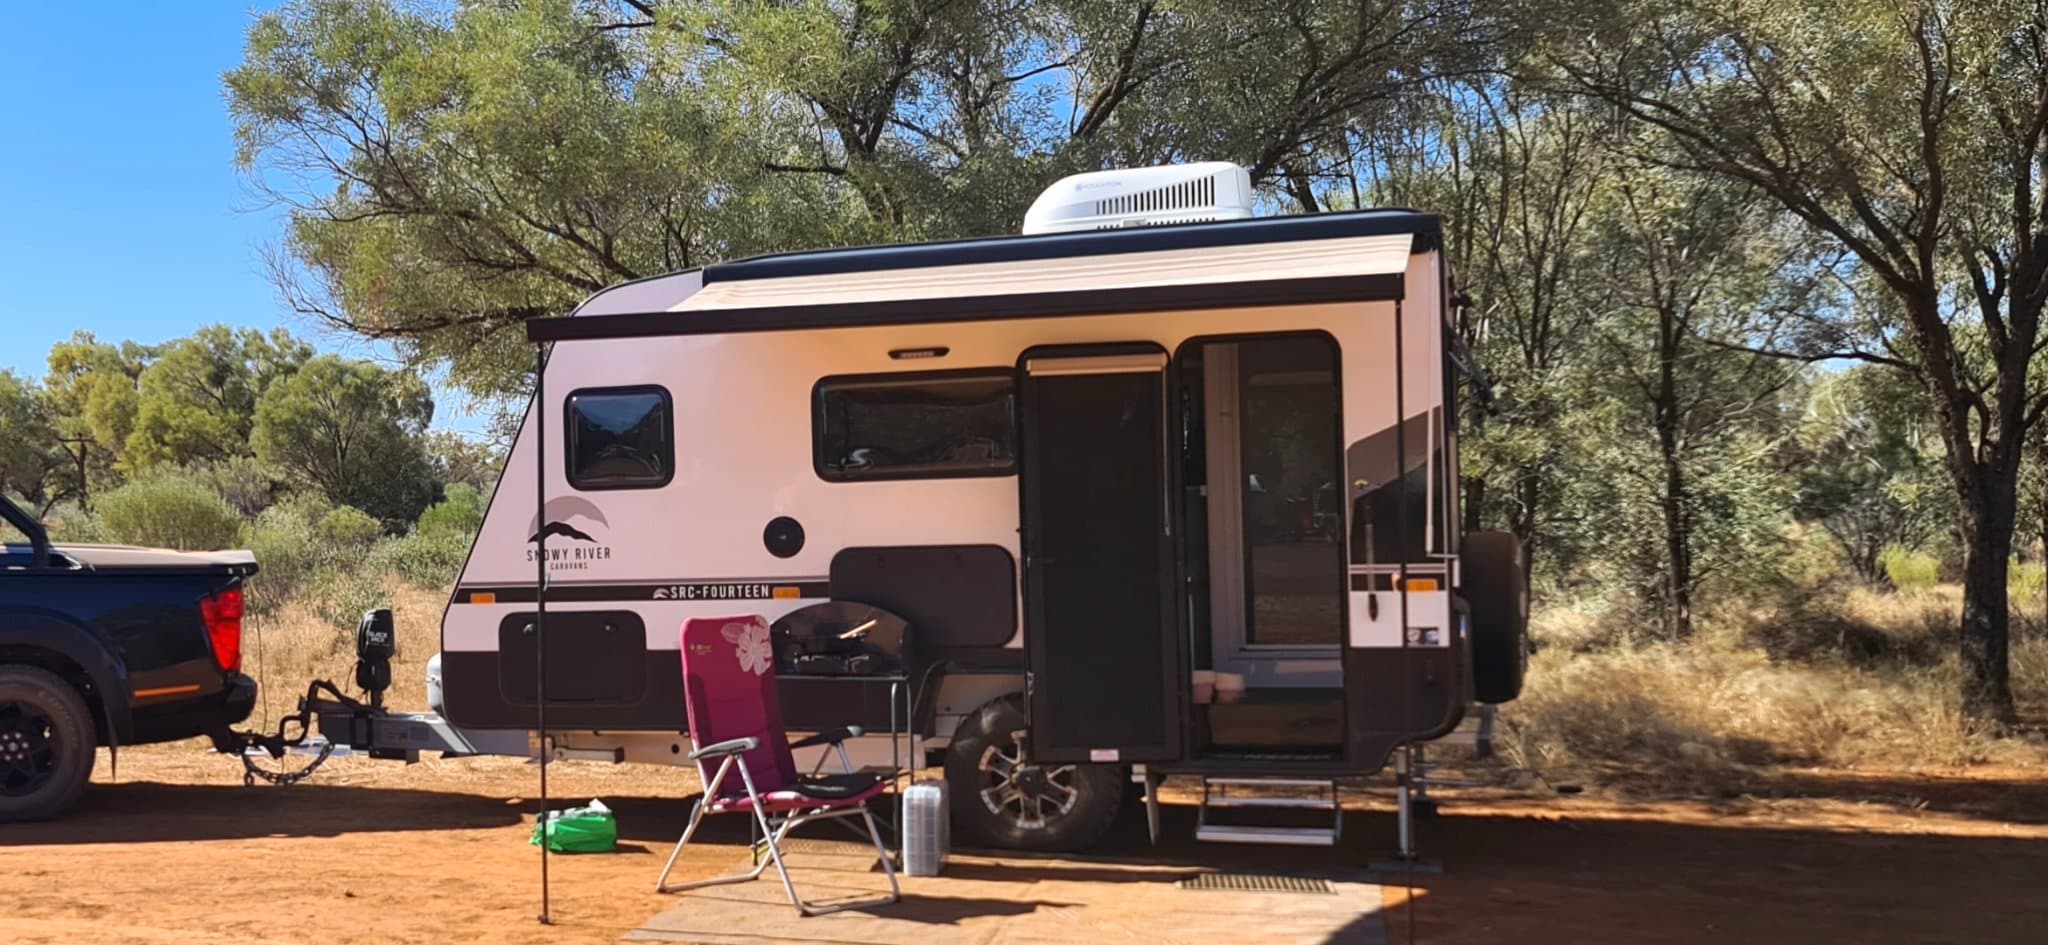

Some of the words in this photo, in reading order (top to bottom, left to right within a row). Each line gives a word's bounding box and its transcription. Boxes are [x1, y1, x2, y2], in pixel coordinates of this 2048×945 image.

[527, 548, 568, 562] SNOWY
[575, 547, 610, 560] RIVER
[550, 562, 588, 570] CARAVANS
[670, 584, 769, 599] SRC-FOURTEEN
